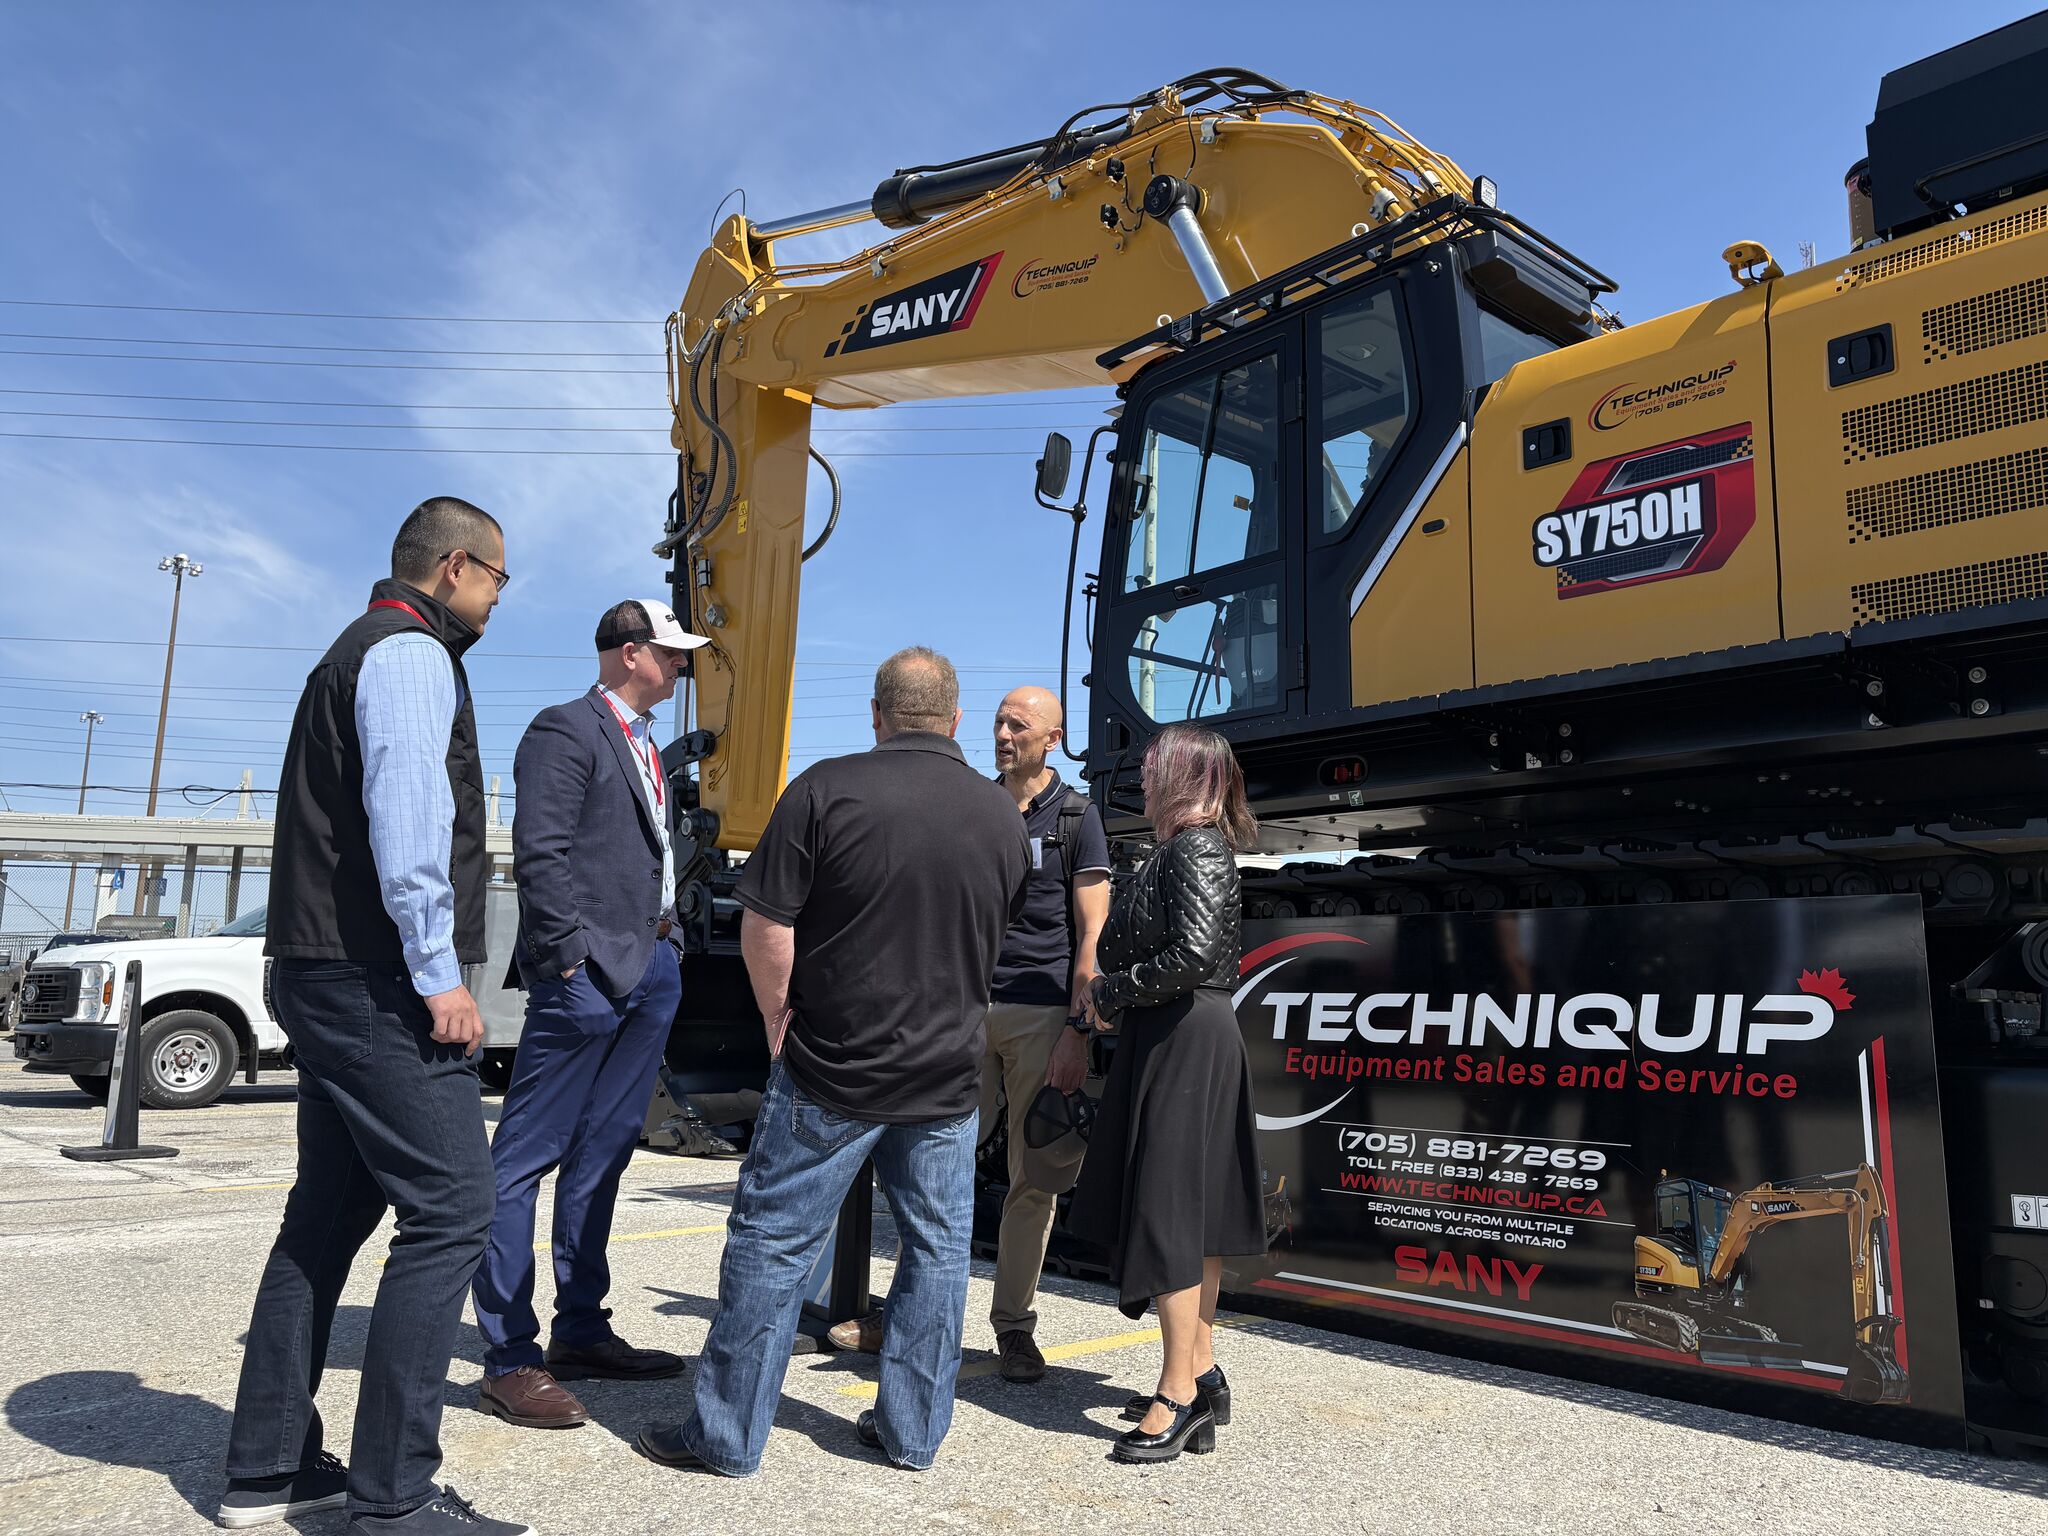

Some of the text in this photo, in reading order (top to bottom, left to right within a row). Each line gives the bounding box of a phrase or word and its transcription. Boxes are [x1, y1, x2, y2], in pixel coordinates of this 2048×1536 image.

[1026, 257, 1097, 280] TECHNIQUIP
[1055, 276, 1089, 288] 881-7269
[870, 289, 961, 338] SANY
[1610, 365, 1734, 410] TECHNIQUIP
[1616, 379, 1728, 416] Equipment Sales and Service
[1634, 386, 1726, 419] (705) 881-7269
[1537, 483, 1702, 564] SY750H
[1261, 992, 1835, 1055] TECHNIQUIP
[1285, 1047, 1798, 1099] Equipment Sales and Service
[1338, 1127, 1607, 1172] (705) 881-7269
[1347, 1156, 1388, 1171] TOLL
[1391, 1161, 1434, 1175] FREE
[1439, 1163, 1484, 1182] (833)
[1488, 1170, 1527, 1184] 438
[1544, 1174, 1599, 1191] 7269
[1340, 1172, 1608, 1217] WWW.TECHNIQUIP.CA
[1768, 1202, 1792, 1213] SANY
[1368, 1201, 1574, 1235] SERVICING YOU FROM MULTIPLE
[1375, 1216, 1567, 1249] LOCATIONS ACROSS ONTARIO
[1394, 1245, 1544, 1301] SANY
